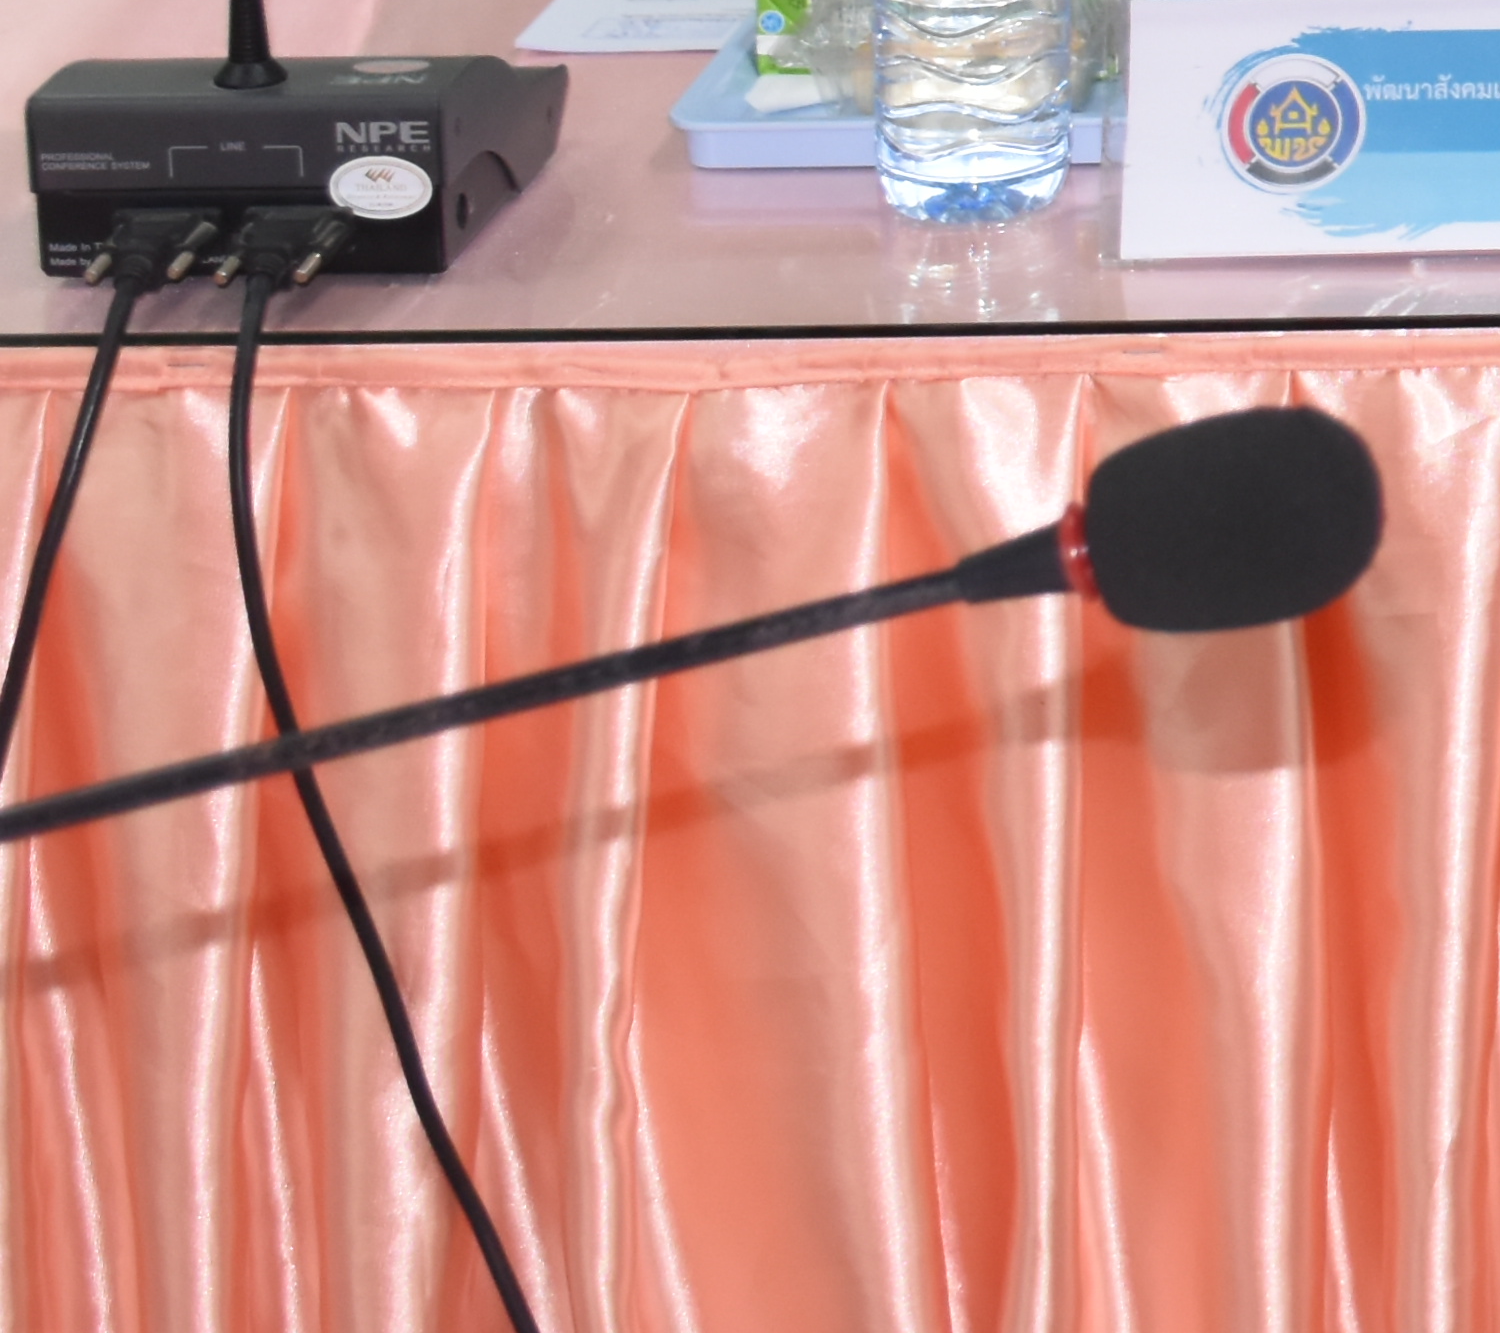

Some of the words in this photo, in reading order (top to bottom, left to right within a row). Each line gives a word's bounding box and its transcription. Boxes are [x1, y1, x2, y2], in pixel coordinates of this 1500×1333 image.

[335, 120, 431, 144] NPE
[219, 141, 246, 152] LINE
[335, 144, 432, 153] RESEARCH
[40, 152, 114, 162] PROFESSIONAL
[41, 161, 107, 171] CONFERENCE
[111, 161, 151, 171] SYSTEM
[48, 242, 78, 252] Made
[49, 257, 77, 267] Made
[79, 257, 92, 268] by
